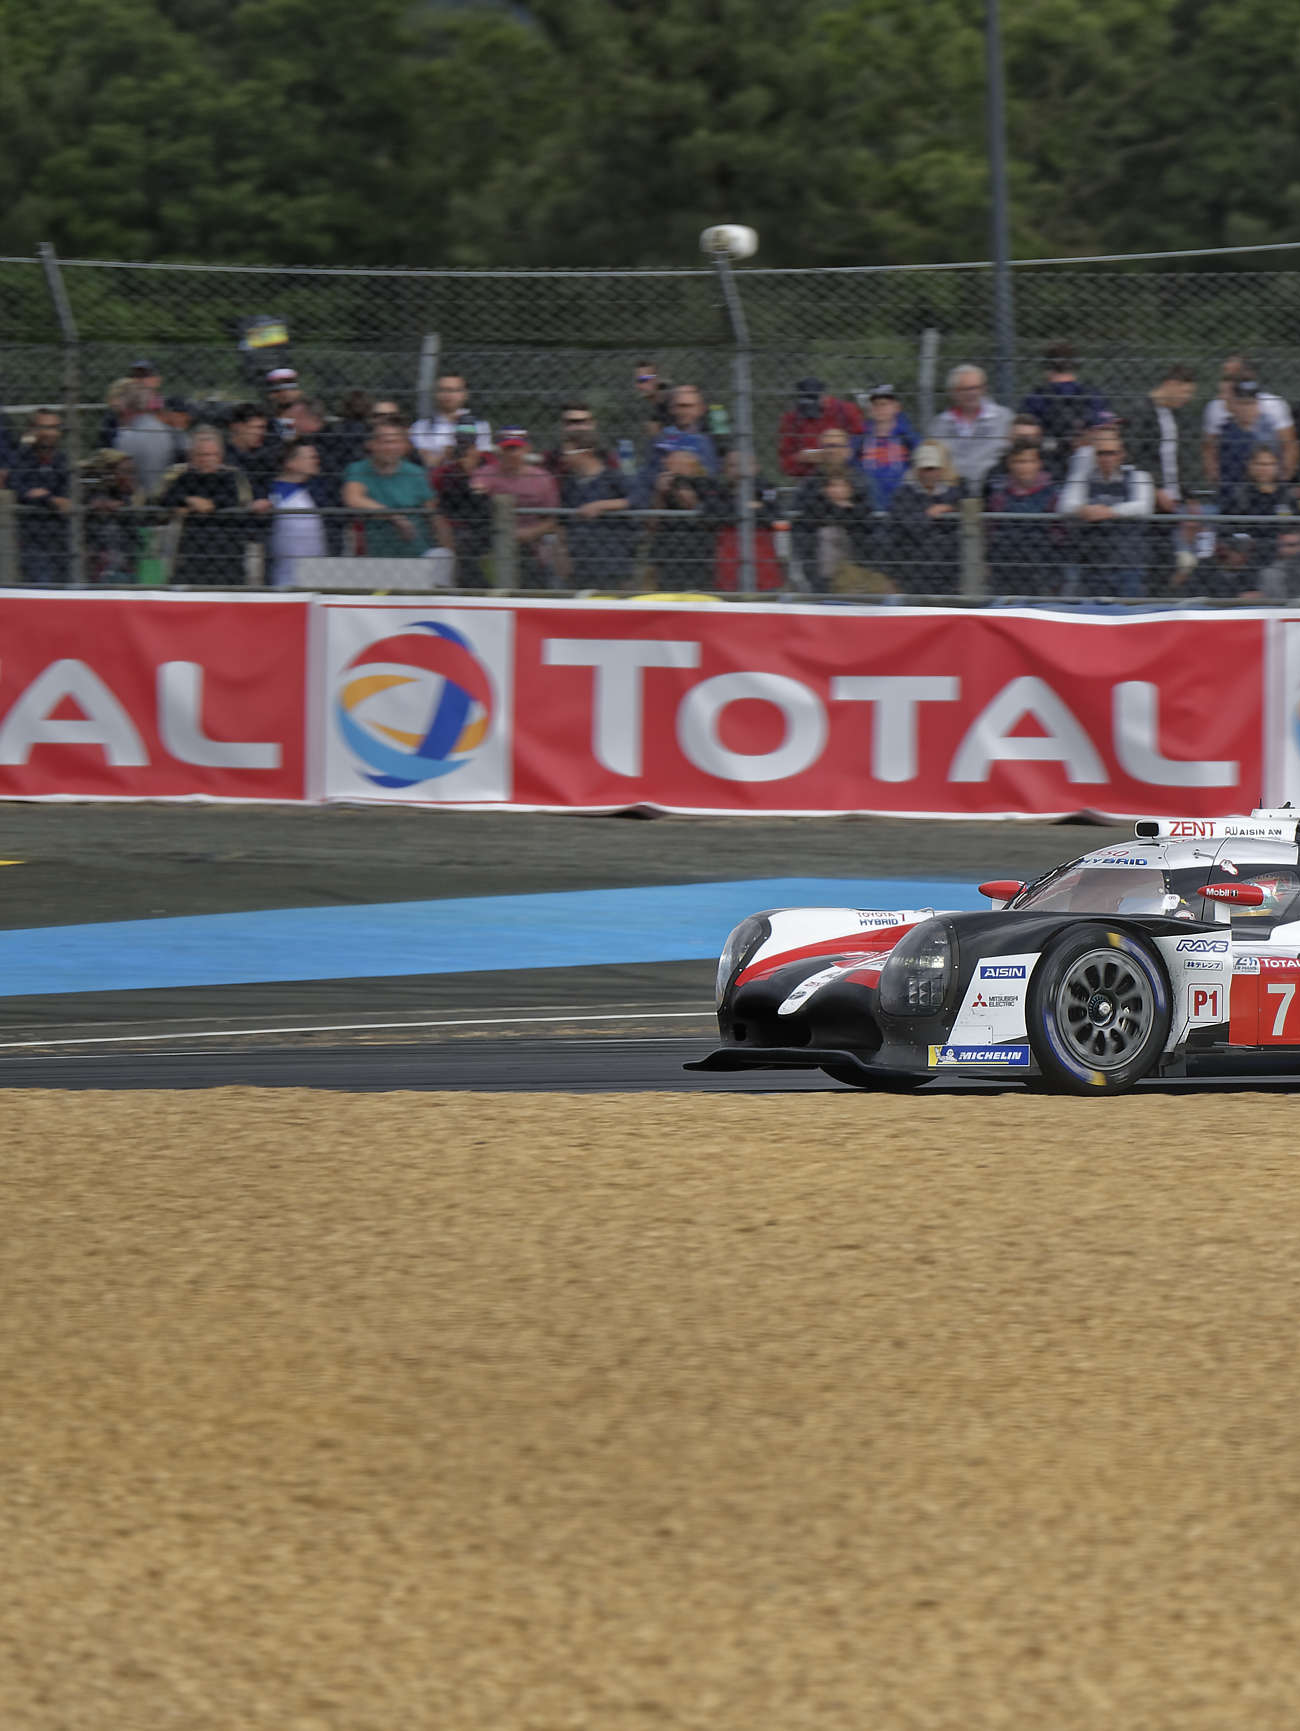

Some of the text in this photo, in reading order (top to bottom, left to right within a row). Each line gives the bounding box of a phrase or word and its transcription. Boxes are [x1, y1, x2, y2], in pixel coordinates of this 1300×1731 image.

[0, 658, 283, 769] AL
[543, 638, 1239, 787] TOTAL
[1169, 821, 1216, 837] ZENT
[1206, 887, 1230, 897] Mobil
[860, 918, 899, 926] HYBRID
[1176, 939, 1229, 953] RAYS
[984, 968, 1023, 977] AISIN
[1193, 990, 1218, 1017] P1
[1267, 983, 1296, 1036] 7
[958, 1051, 1022, 1060] MICHELIN
